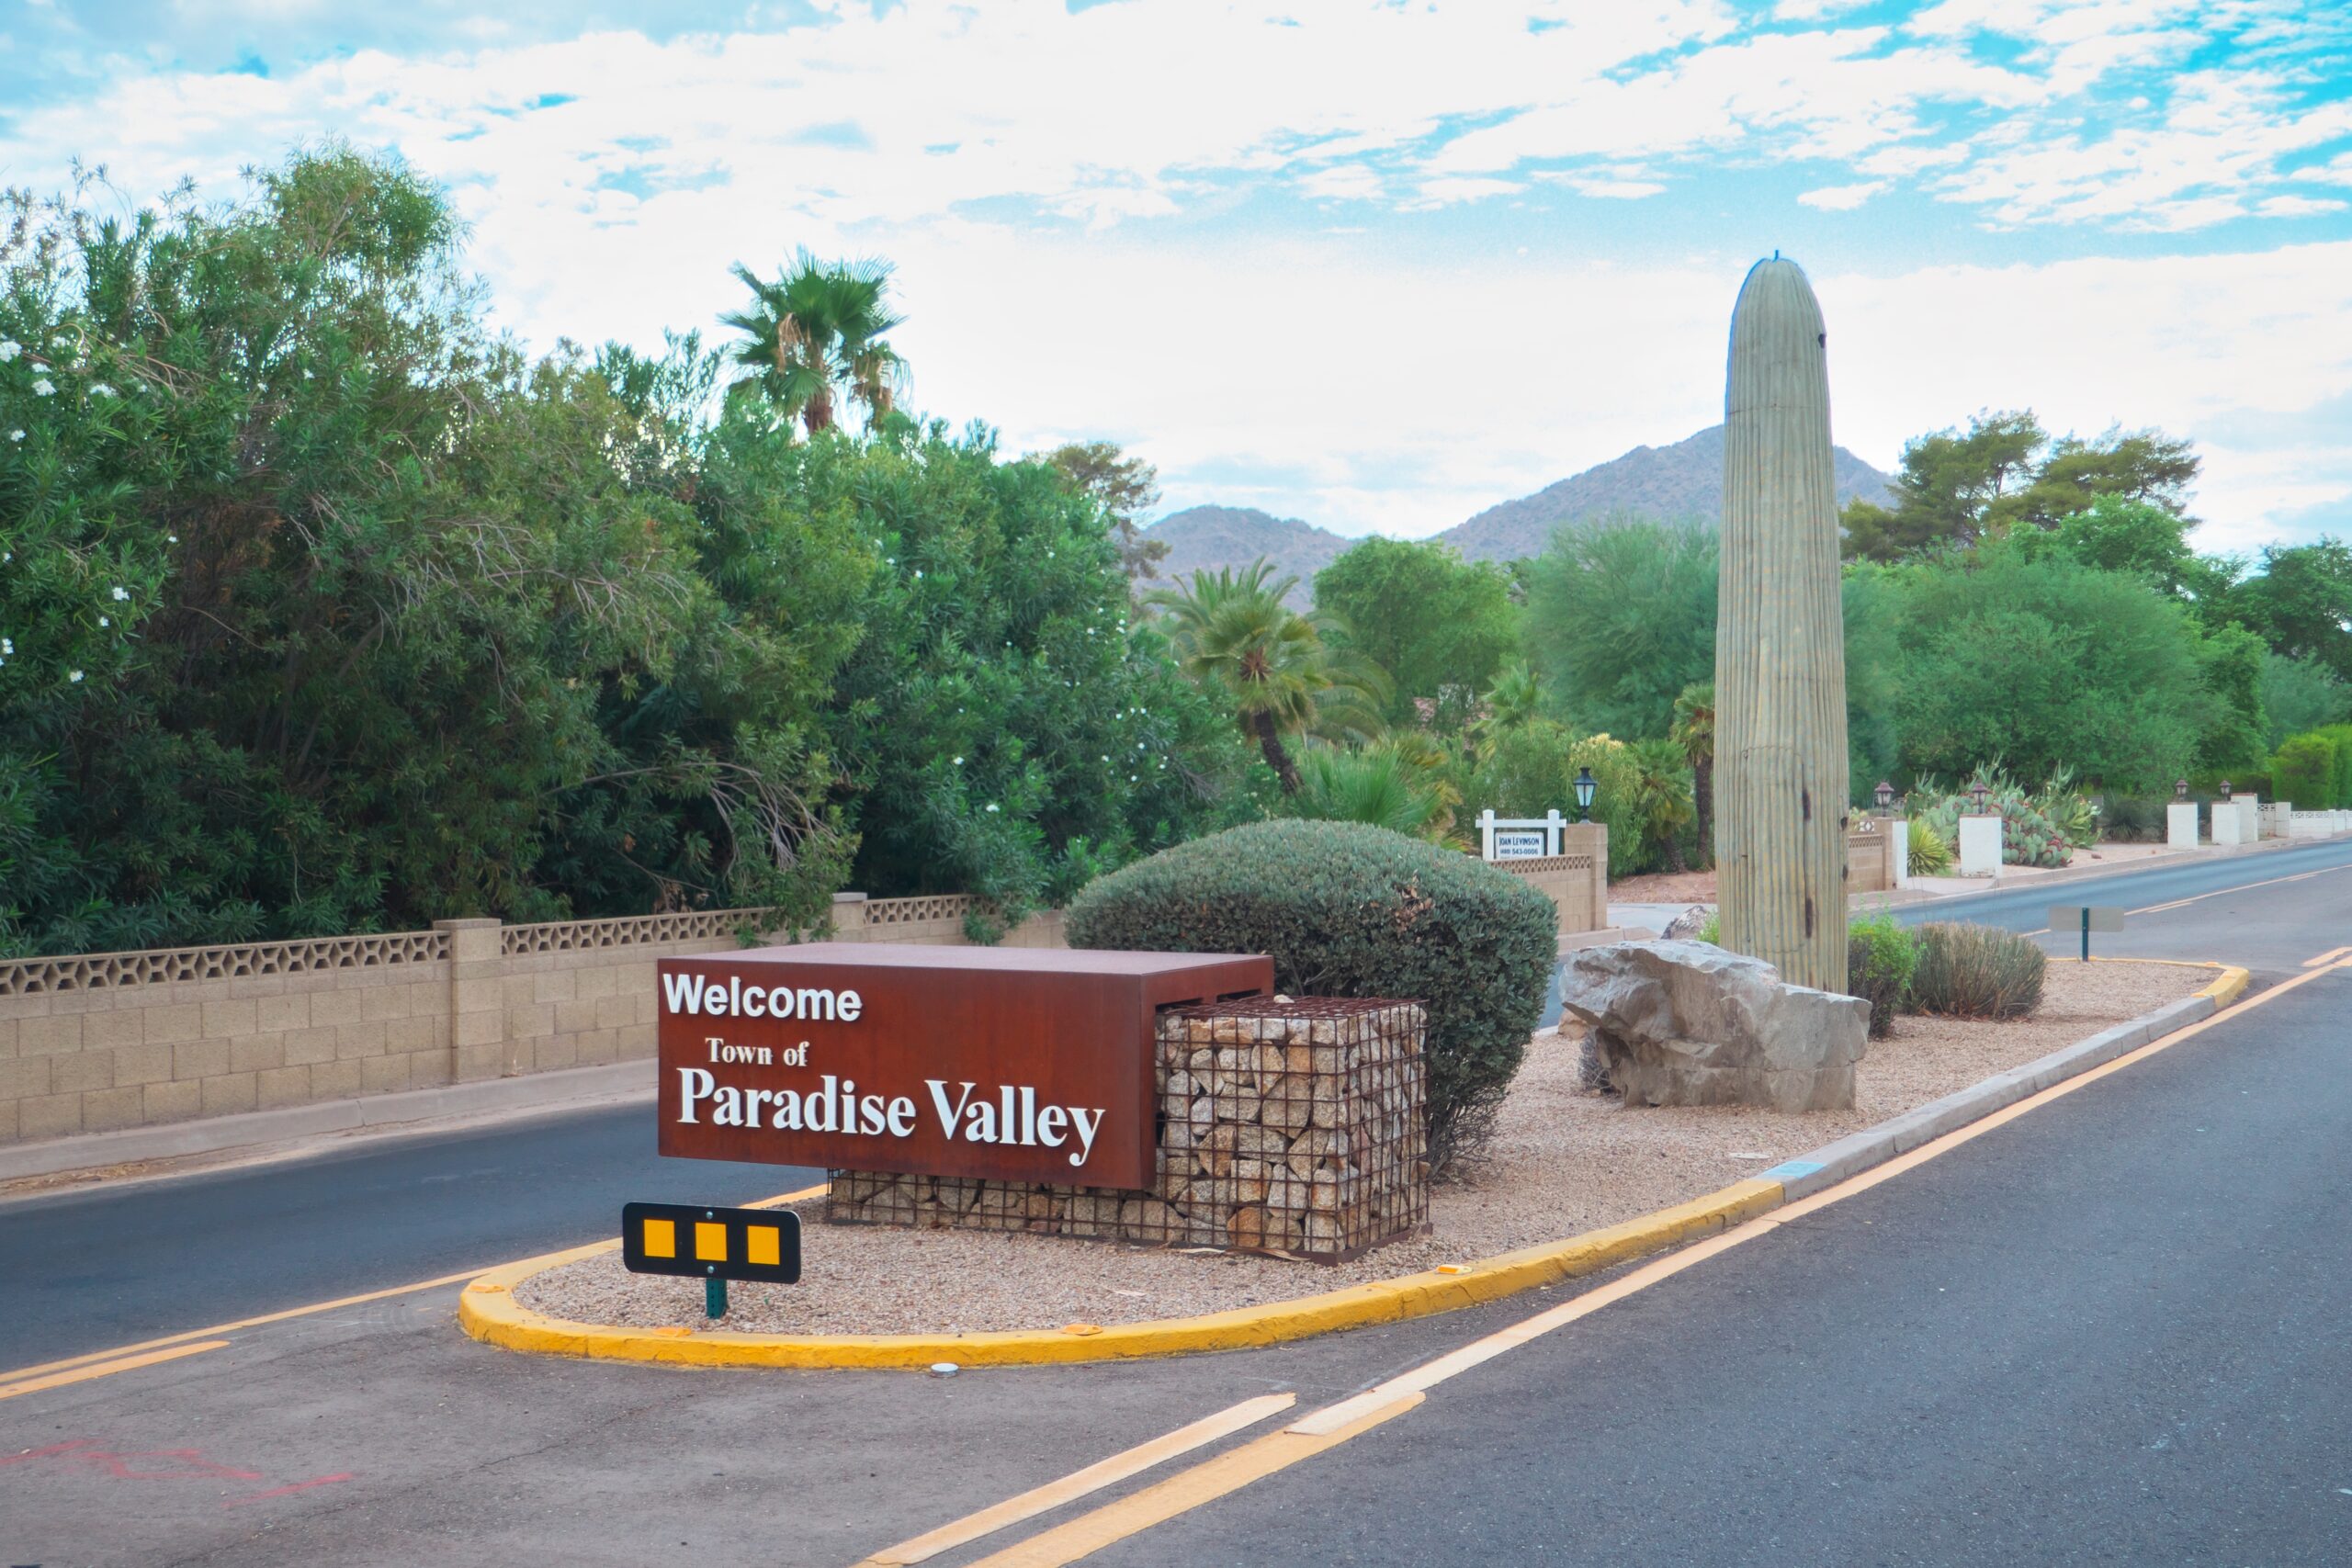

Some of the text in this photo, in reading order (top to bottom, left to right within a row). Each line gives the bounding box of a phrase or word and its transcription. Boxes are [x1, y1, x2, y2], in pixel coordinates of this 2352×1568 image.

[1499, 837, 1539, 846] JOAN LEVINSON
[662, 973, 863, 1022] Welcome
[706, 1038, 810, 1067] Town of
[675, 1067, 1106, 1167] Paradise Valley
